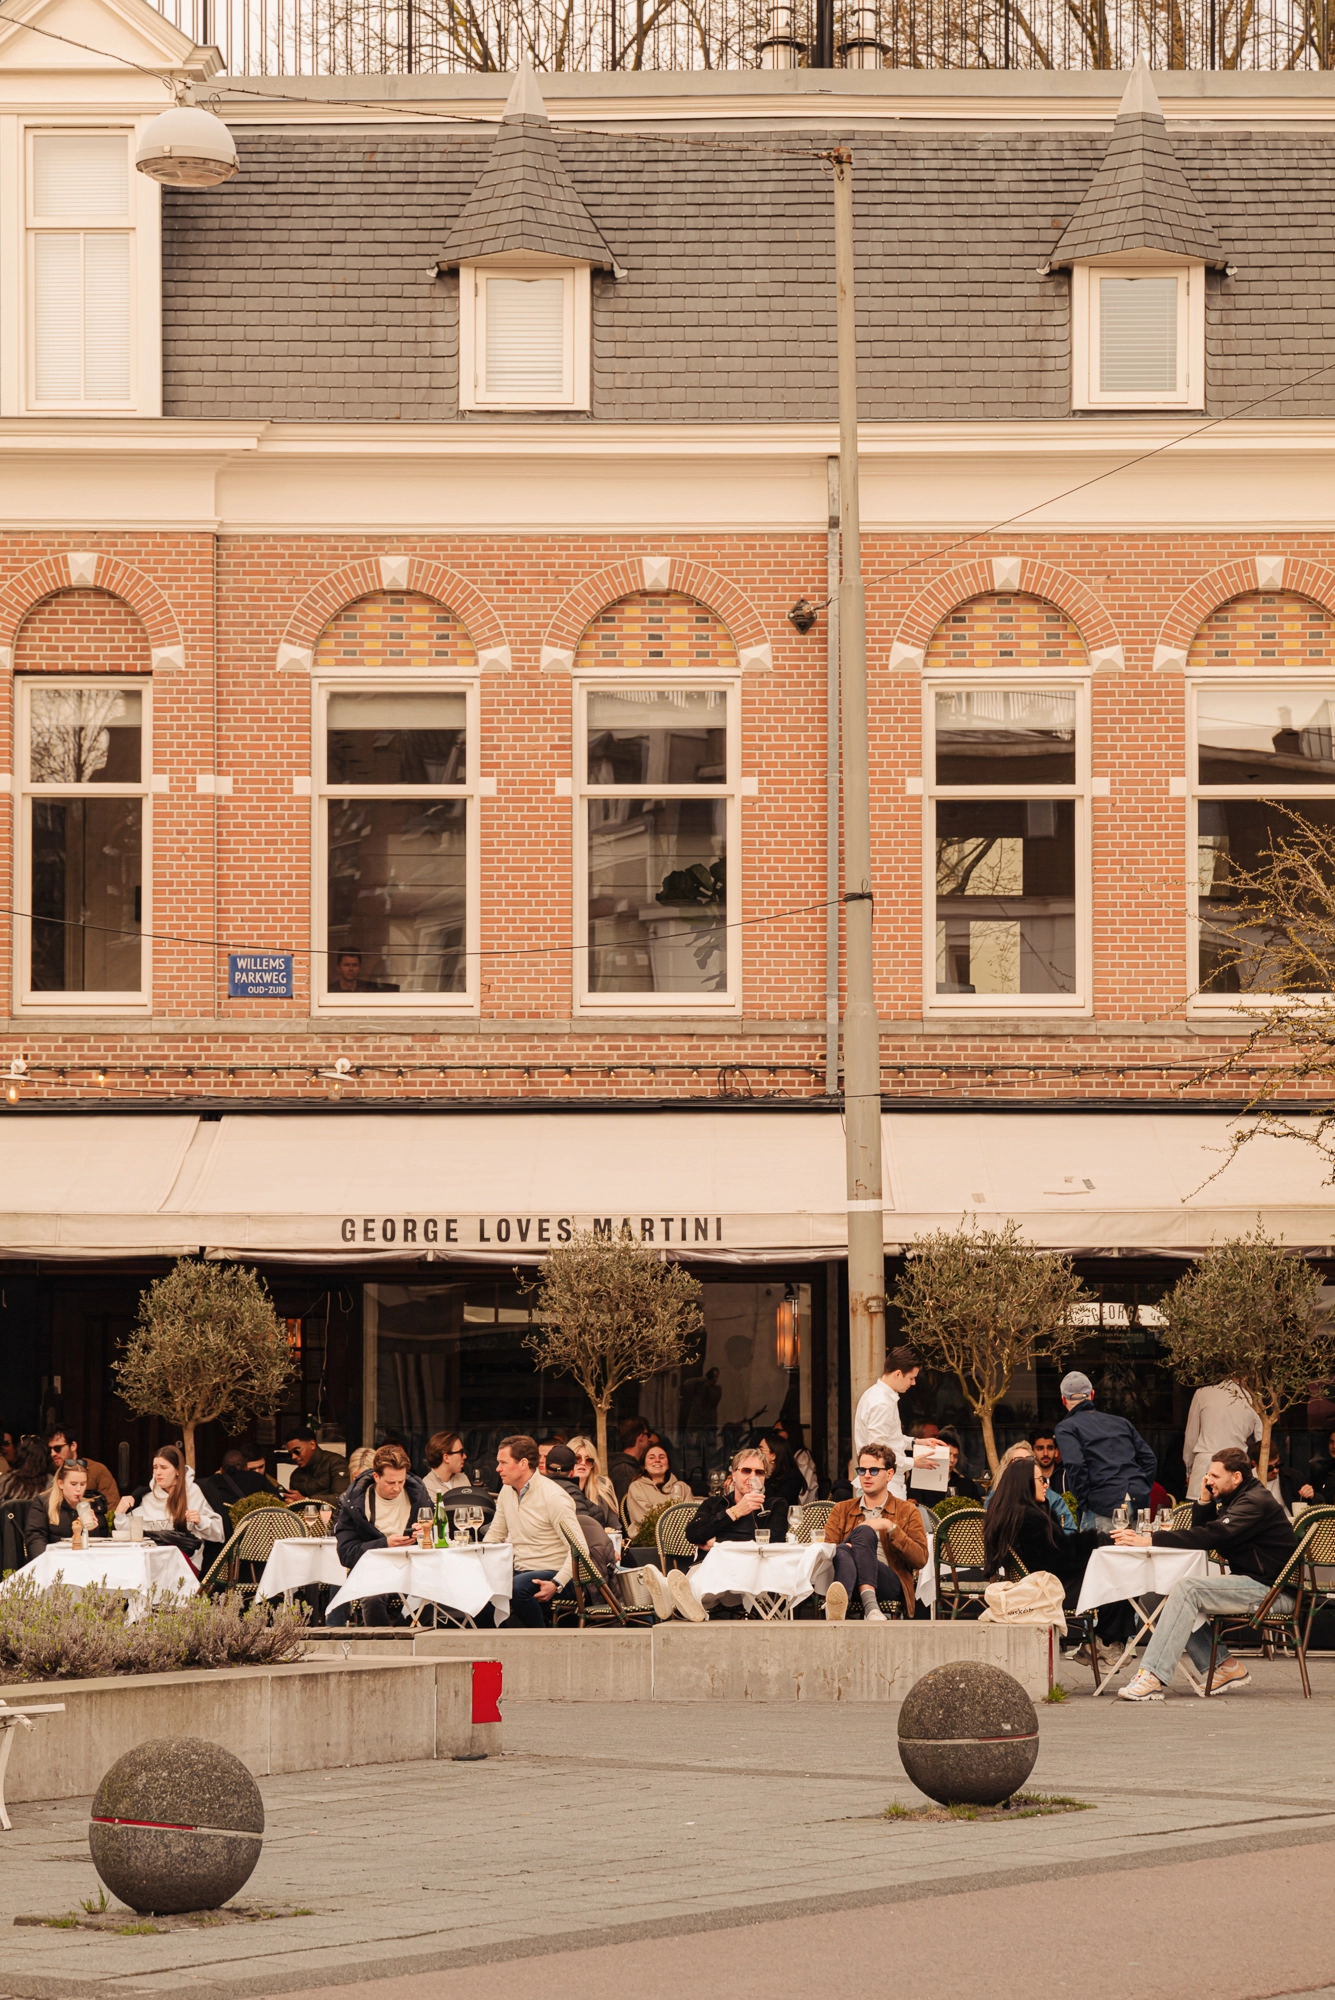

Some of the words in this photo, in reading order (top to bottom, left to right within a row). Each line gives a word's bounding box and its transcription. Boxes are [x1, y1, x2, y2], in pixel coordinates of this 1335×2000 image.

[236, 957, 285, 970] WILLEMS
[234, 971, 287, 984] PARKWEG
[247, 985, 287, 994] OUD-ZUID
[341, 1218, 459, 1243] GEORGE
[479, 1217, 572, 1243] LOVES
[593, 1217, 722, 1242] MARTINI
[1091, 1304, 1143, 1323] GEORGE
